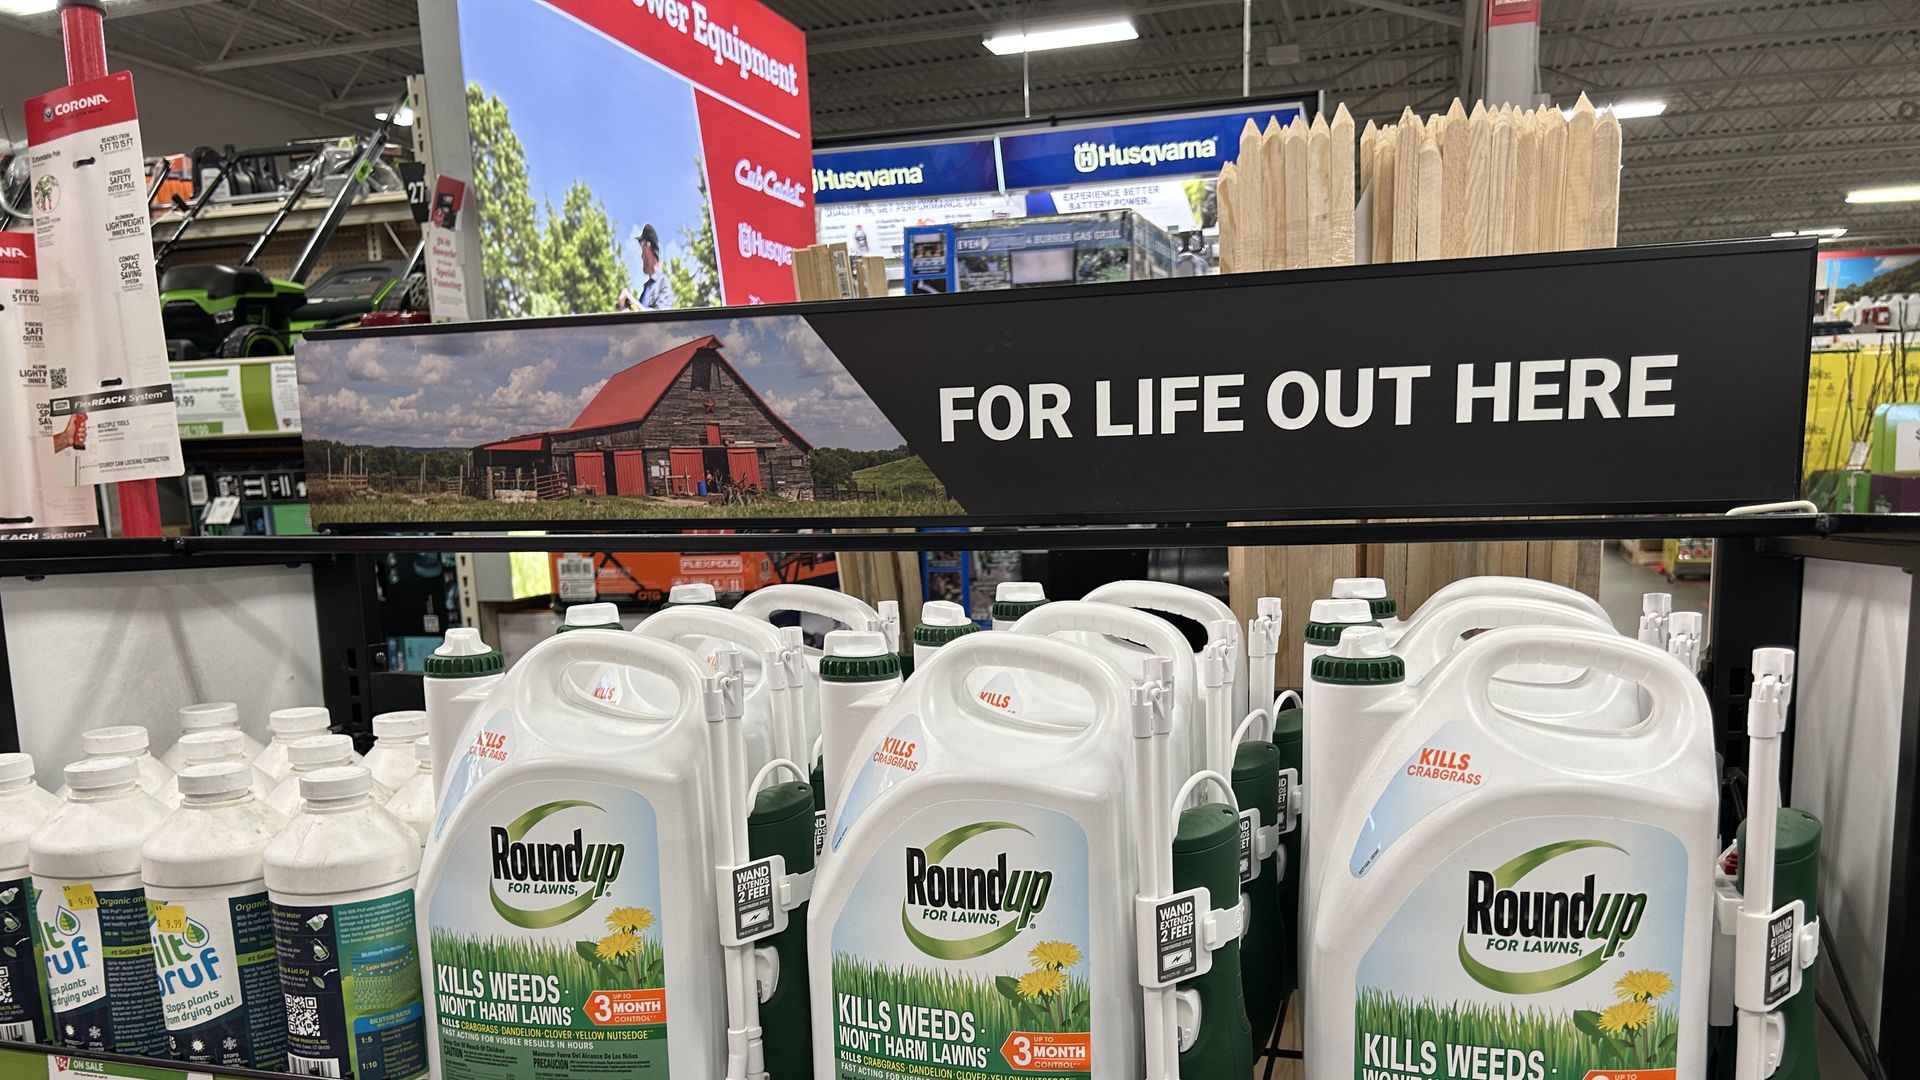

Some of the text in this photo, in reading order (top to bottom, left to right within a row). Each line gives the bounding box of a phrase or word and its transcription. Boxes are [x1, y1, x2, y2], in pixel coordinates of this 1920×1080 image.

[692, 1, 799, 96] Equipment
[55, 94, 109, 116] CORONA
[1099, 139, 1216, 167] Husqvarna
[109, 174, 132, 185] SAFETY
[735, 158, 806, 207] Cub Cadet
[818, 166, 922, 191] Husqvarna
[408, 182, 424, 204] 27
[105, 216, 145, 231] LIGHTWEIGHT
[120, 261, 139, 271] SPACE
[120, 269, 142, 280] SAVING
[939, 354, 1679, 443] FOR LIFE OUT HERE
[980, 691, 1011, 709] KILLS
[881, 736, 916, 758] KILLS
[872, 751, 919, 772] CRABGRASS
[1418, 747, 1471, 771] KILLS
[1407, 764, 1482, 786] CRABGRASS
[736, 865, 769, 884] WAND
[737, 876, 770, 893] EXTENDS
[508, 882, 530, 893] FOR
[738, 884, 771, 904] 2 FEET
[100, 897, 131, 907] Organic
[1159, 901, 1193, 921] WAND
[166, 919, 182, 929] 9.99
[922, 908, 948, 922] FOR
[1160, 913, 1193, 931] EXTENDS
[1160, 921, 1194, 943] 2 FEET
[1771, 915, 1792, 938] WAND
[1486, 938, 1519, 952] FOR
[1770, 929, 1792, 948] EXTENDS
[1769, 939, 1792, 962] 2 FEET
[60, 979, 87, 994] plants
[437, 963, 561, 1004] KILLS WEEDS
[57, 985, 100, 1007] drying out!
[165, 989, 220, 1014] Stops plants
[181, 1006, 213, 1022] drying
[213, 995, 234, 1009] out!
[439, 994, 477, 1020] WON'T
[479, 1002, 519, 1023] HARM
[594, 994, 661, 1023] 3 MONTH
[838, 992, 976, 1044] KILLS WEEDS
[441, 1017, 460, 1029] KILLS
[361, 1035, 373, 1044] 1:5
[442, 1027, 594, 1050] FAST ACTING FOR VISIBLE RESULTS IN HOURS
[839, 1025, 881, 1054] WON'T
[885, 1035, 928, 1062] HARM
[443, 1045, 463, 1058] CAUTION
[840, 1050, 862, 1064] KILLS
[1012, 1036, 1086, 1067] 3 MONTH
[1363, 1032, 1545, 1080] KILLS WEEDS
[73, 1060, 104, 1072] ON SALE
[362, 1061, 378, 1070] 1:10
[841, 1061, 857, 1073] FAST
[858, 1065, 884, 1079] ACTING
